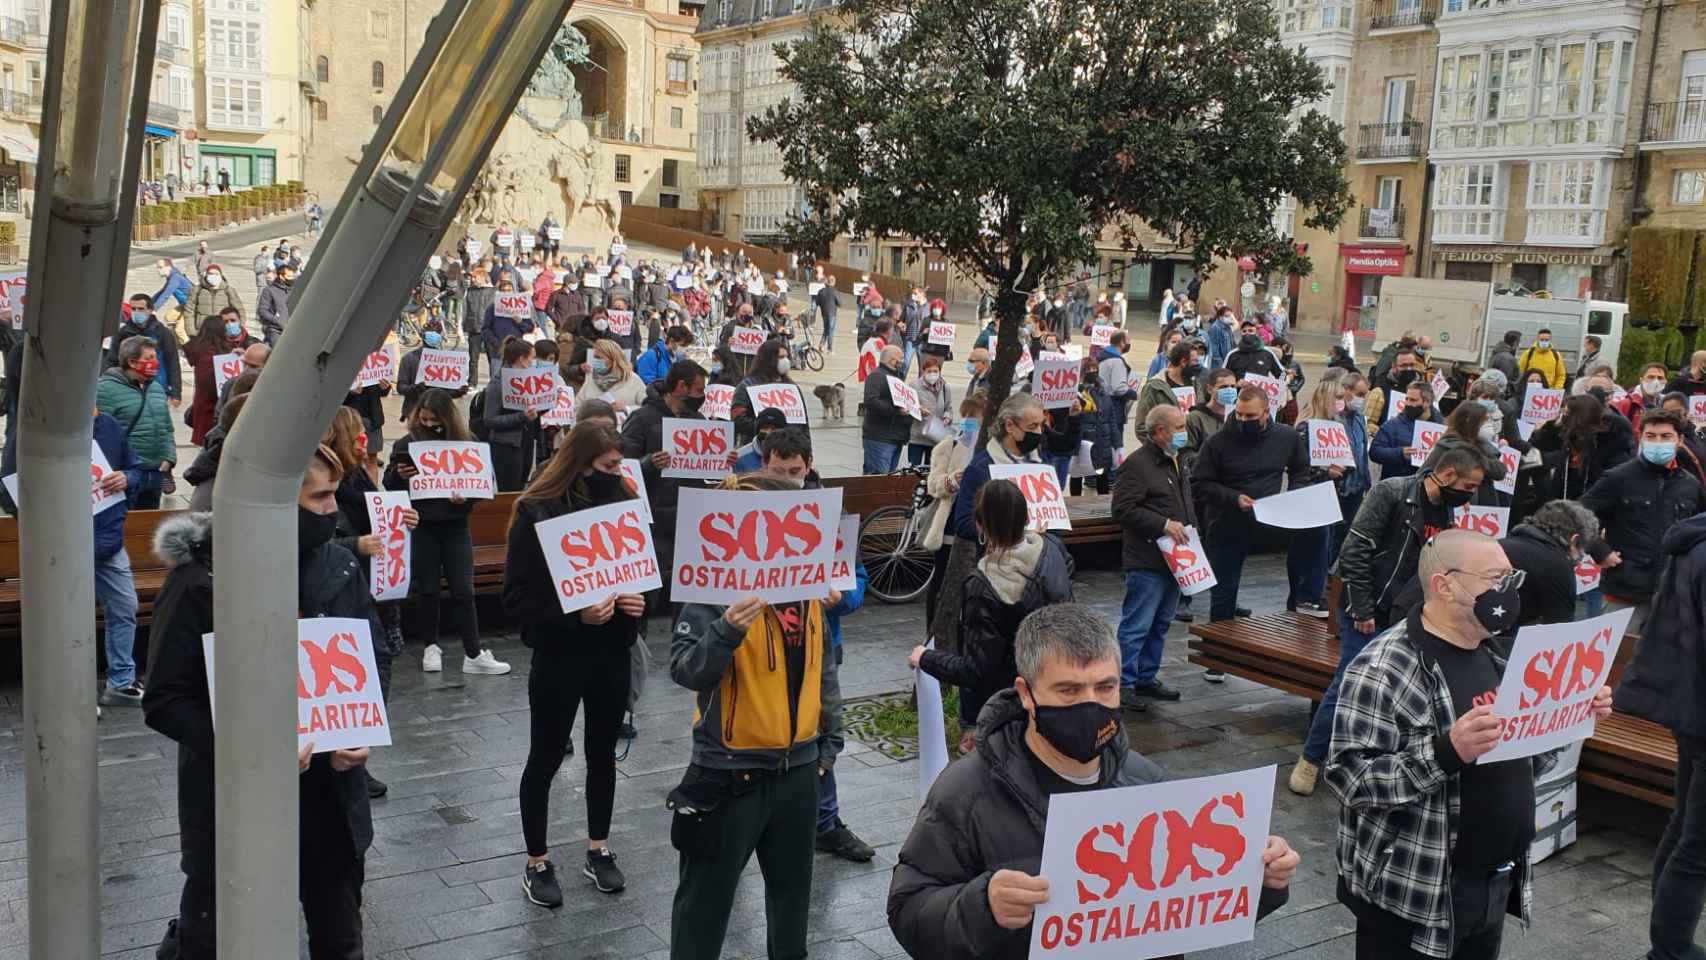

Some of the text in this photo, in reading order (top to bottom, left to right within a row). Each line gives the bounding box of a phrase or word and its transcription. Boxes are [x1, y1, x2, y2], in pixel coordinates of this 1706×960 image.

[1349, 257, 1399, 268] Mendia Optika
[1440, 252, 1504, 263] TEJIDOS
[500, 296, 528, 309] SOS
[609, 314, 631, 326] SOS
[933, 325, 954, 337] SOS
[738, 332, 764, 345] SOS
[424, 364, 462, 383] SOS
[509, 371, 554, 395] SOS
[1041, 364, 1079, 391] SOS
[757, 388, 798, 408] SOS
[1531, 394, 1561, 410] SOS
[672, 427, 728, 456] SOS
[1316, 427, 1350, 448] SOS
[419, 447, 484, 475] SOS
[412, 477, 490, 490] OSTALARITZA
[1015, 471, 1060, 503] OS
[373, 495, 386, 596] OSTARITZA
[386, 504, 406, 587] SOS
[560, 510, 646, 572] SOS
[698, 502, 822, 562] SOS
[560, 558, 657, 598] OSTALARITZA
[678, 560, 826, 591] OSTALARITZA
[296, 632, 368, 700] OS
[1519, 627, 1613, 710] SOS
[296, 702, 384, 735] LARITZA
[1075, 791, 1246, 905] SOS
[1040, 886, 1250, 950] OSTALARITZA
